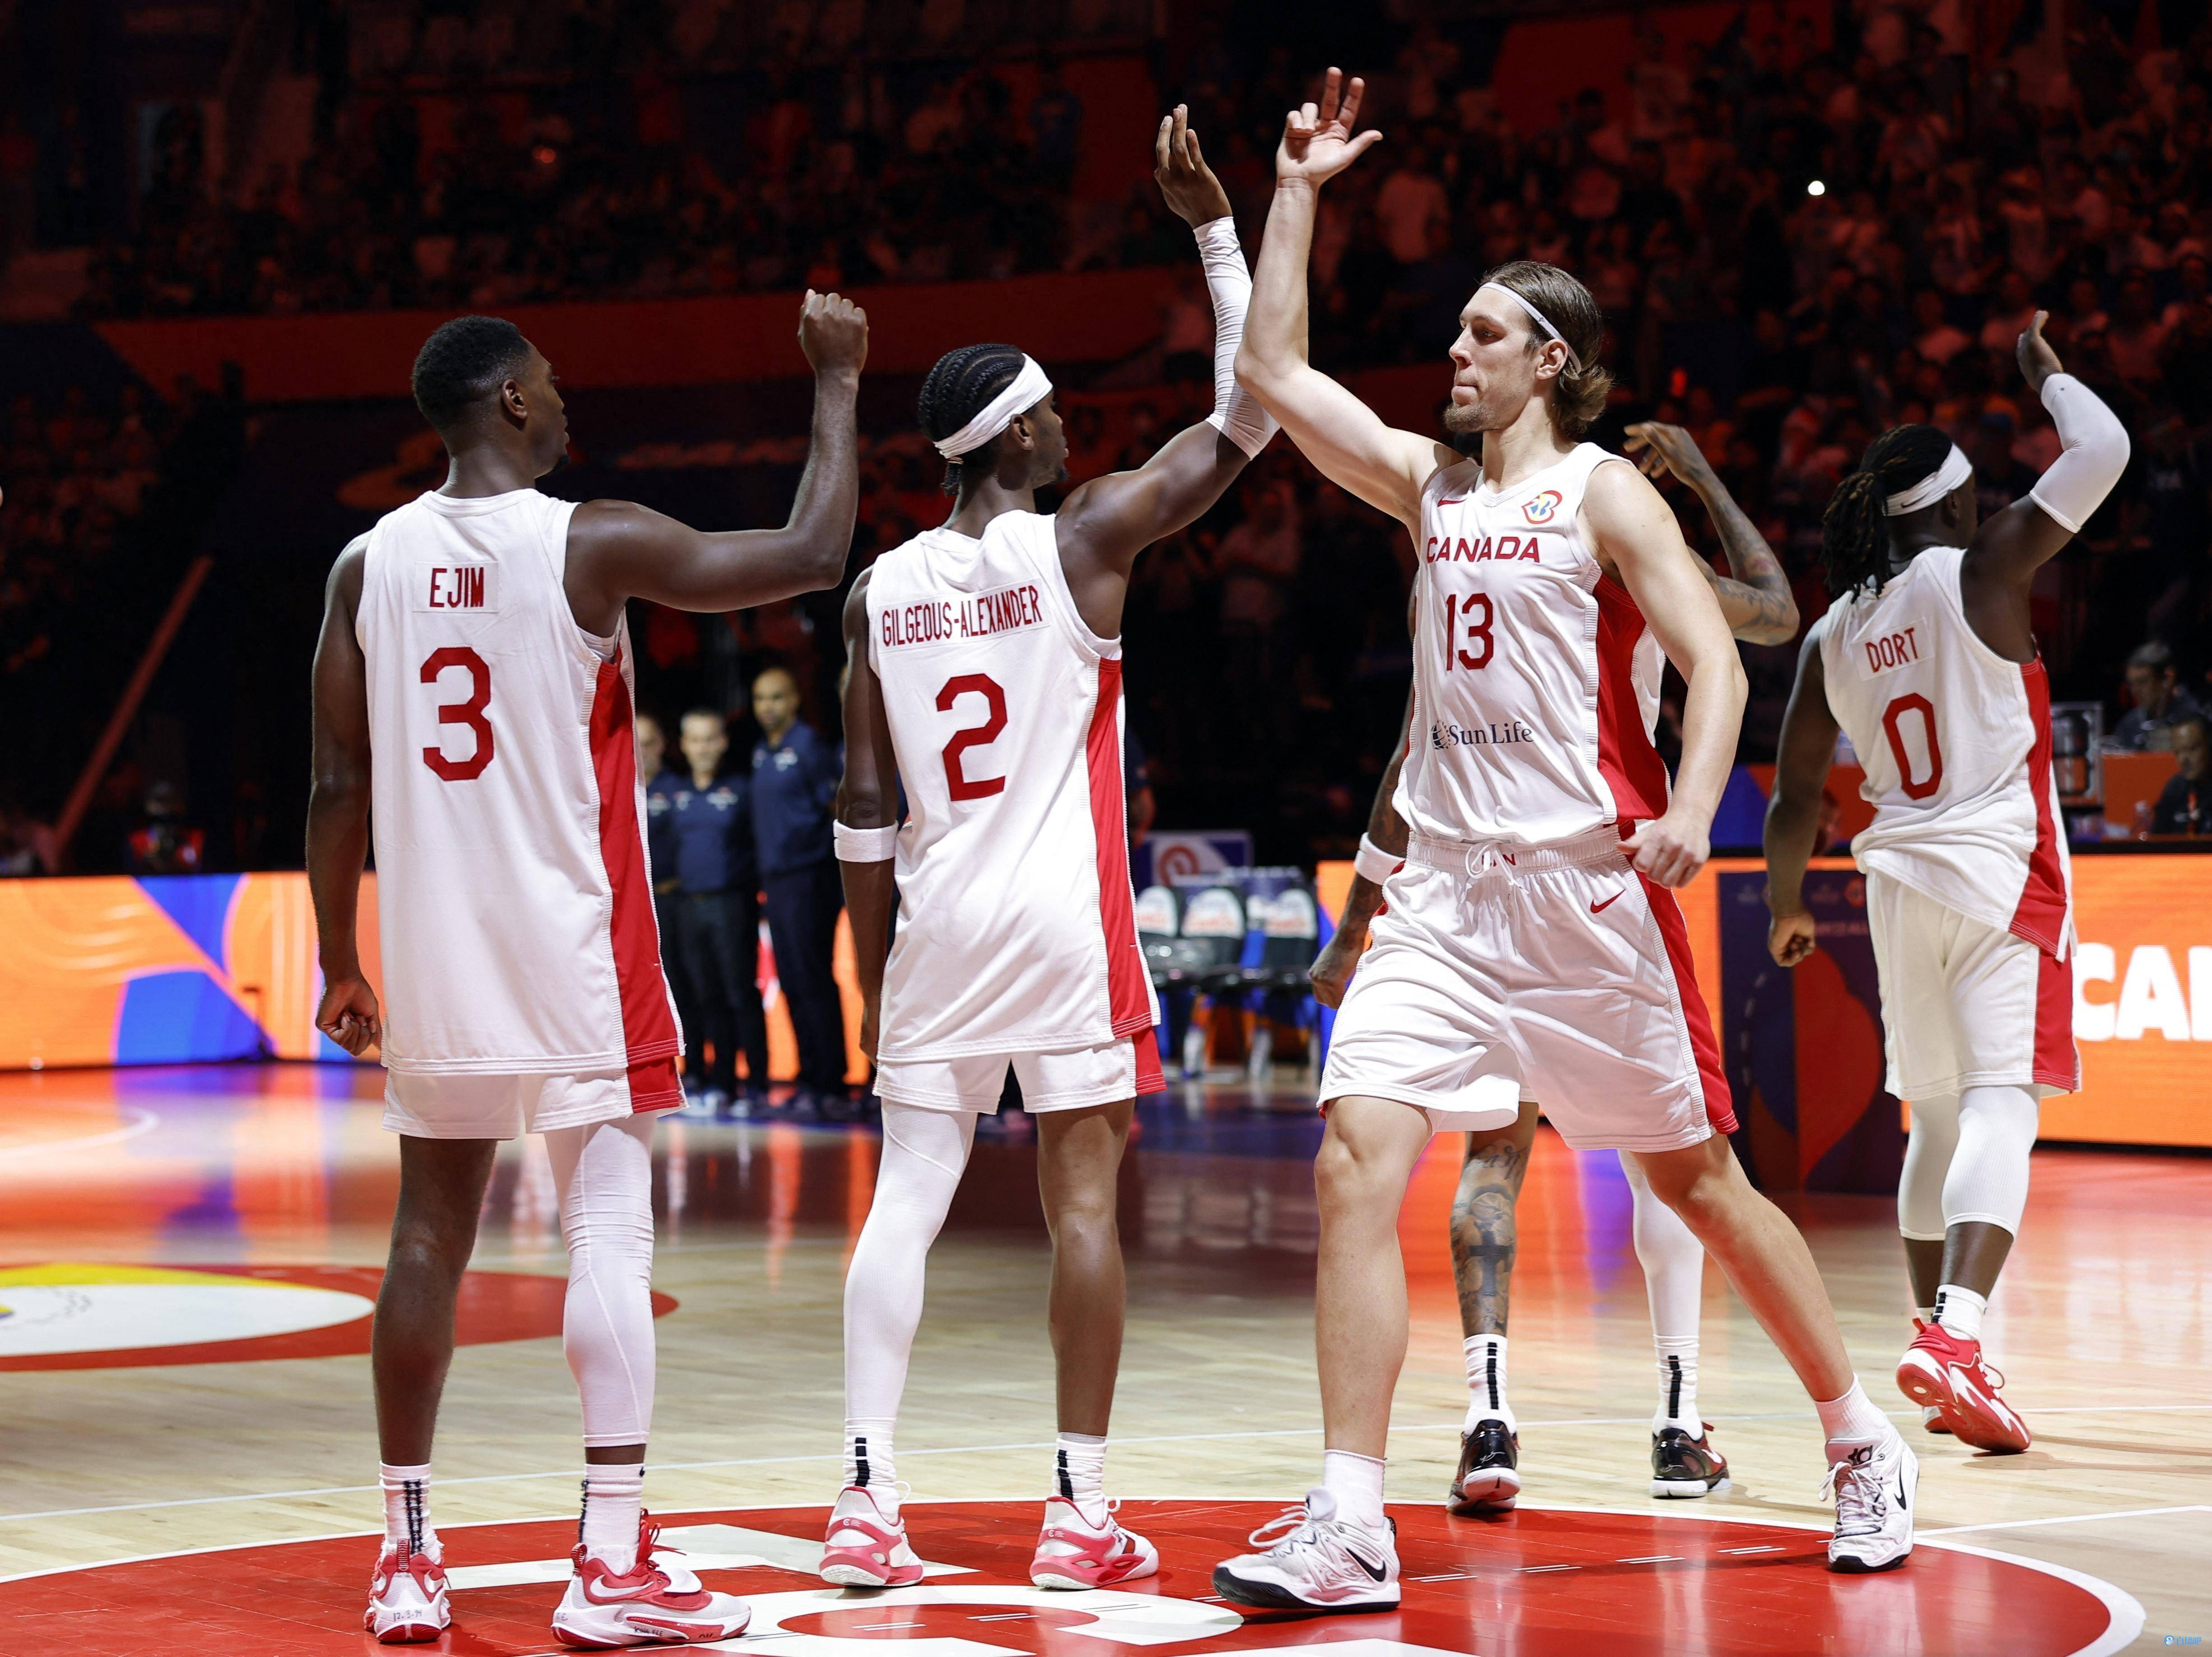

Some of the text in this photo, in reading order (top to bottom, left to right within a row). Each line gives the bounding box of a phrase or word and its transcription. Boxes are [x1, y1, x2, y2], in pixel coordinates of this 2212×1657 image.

[1426, 536, 1540, 563] CANADA
[429, 567, 484, 608] EJIM
[882, 585, 1043, 647] GILGEOUS-ALEXANDER
[1446, 592, 1494, 671] 13
[1865, 627, 1918, 673] DORT
[420, 647, 494, 781] 3
[936, 673, 1007, 801] 2
[1449, 721, 1534, 746] Sun Life
[1882, 692, 1943, 801] 0
